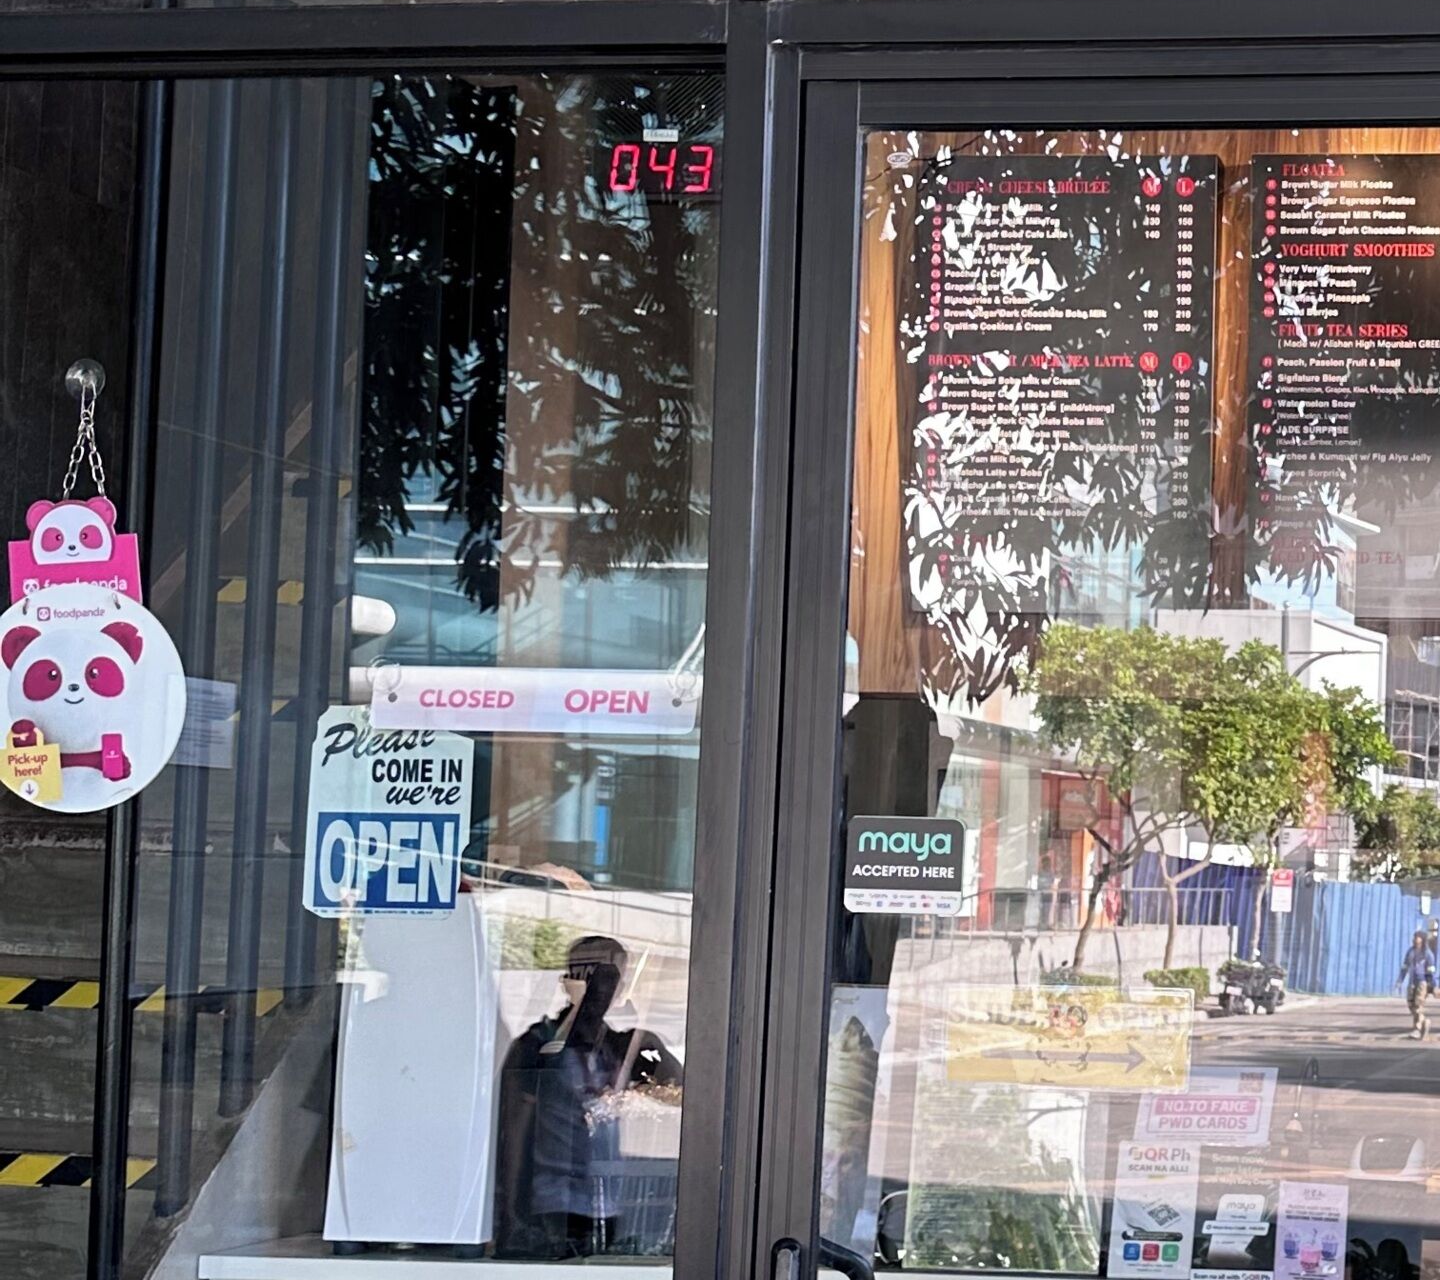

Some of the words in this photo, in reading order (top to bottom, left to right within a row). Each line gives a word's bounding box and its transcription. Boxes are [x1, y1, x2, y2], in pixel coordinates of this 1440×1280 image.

[609, 144, 713, 193] 043
[1280, 226, 1309, 235] Brown
[1310, 226, 1337, 237] Sugar
[1281, 243, 1349, 257] YOGHURT
[1353, 242, 1436, 258] SMOOTHIES
[1326, 324, 1353, 338] TEA
[1358, 324, 1408, 338] SERIES
[1355, 340, 1375, 351] High
[1377, 340, 1417, 350] Mountain
[928, 354, 973, 367] BROWN
[1309, 358, 1345, 367] Passion
[942, 402, 969, 411] Brown
[970, 402, 996, 413] Sugar
[1331, 399, 1356, 409] Snow
[53, 607, 106, 621] foodpanda
[419, 688, 516, 709] CLOSED
[564, 689, 651, 714] OPEN
[321, 723, 436, 767] Please
[8, 753, 48, 767] Pick-up
[14, 765, 42, 778] here!
[371, 758, 433, 783] COME
[441, 758, 463, 783] IN
[386, 783, 462, 806] we're
[858, 831, 952, 861] maya
[319, 818, 456, 904] OPEN
[852, 864, 920, 878] ACCEPTED
[922, 866, 955, 879] HERE
[1210, 1100, 1249, 1113] FAKE
[1158, 1116, 1193, 1129] PWD
[1196, 1116, 1248, 1130] CARDS
[1128, 1164, 1153, 1173] SCAN
